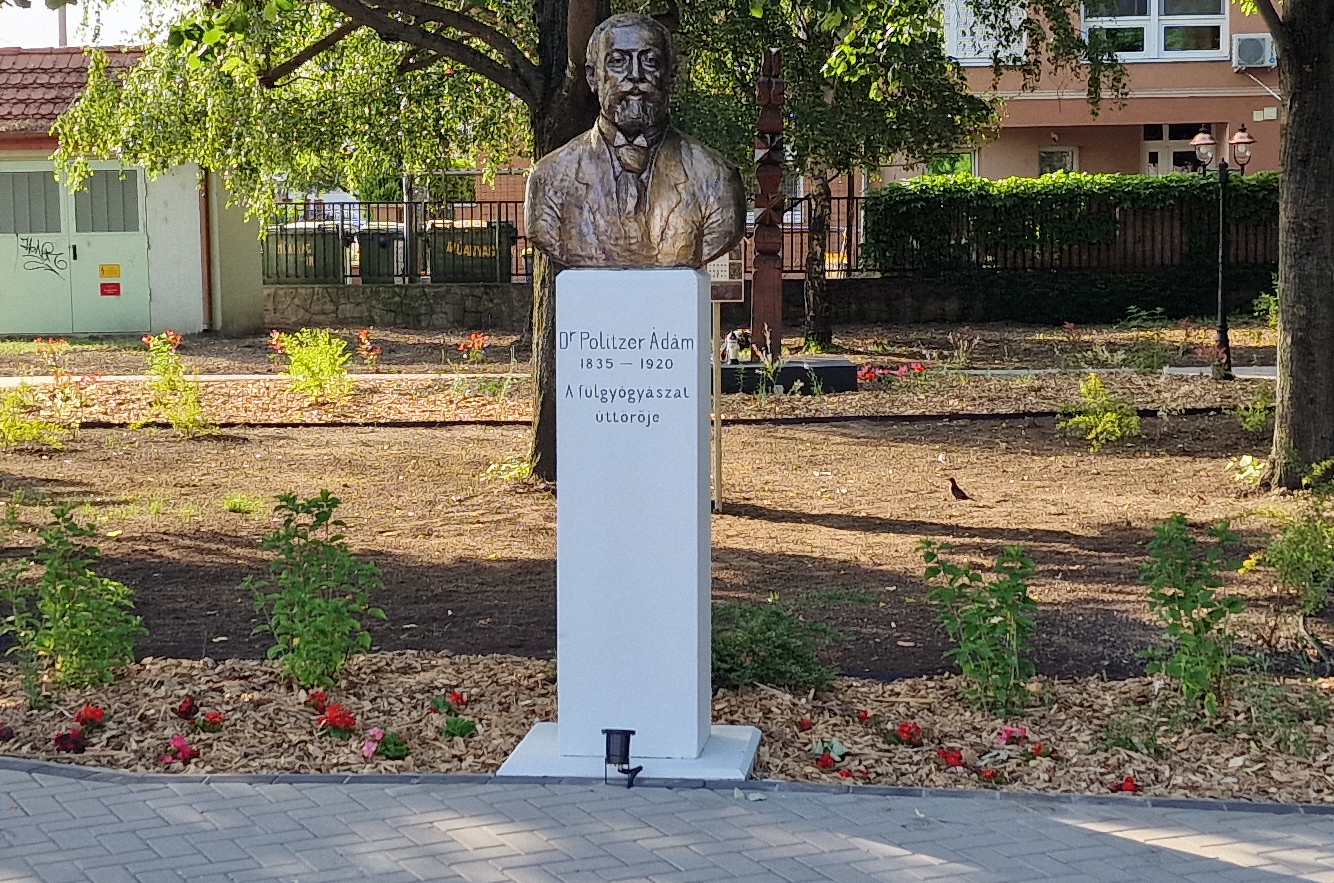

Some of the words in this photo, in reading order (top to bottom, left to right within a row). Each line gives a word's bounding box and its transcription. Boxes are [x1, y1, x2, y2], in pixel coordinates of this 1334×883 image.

[559, 330, 577, 350] Dr
[580, 330, 646, 351] Politzer
[649, 326, 695, 351] Ádám
[580, 357, 614, 370] 1835
[640, 357, 674, 370] 1920
[565, 384, 574, 399] A
